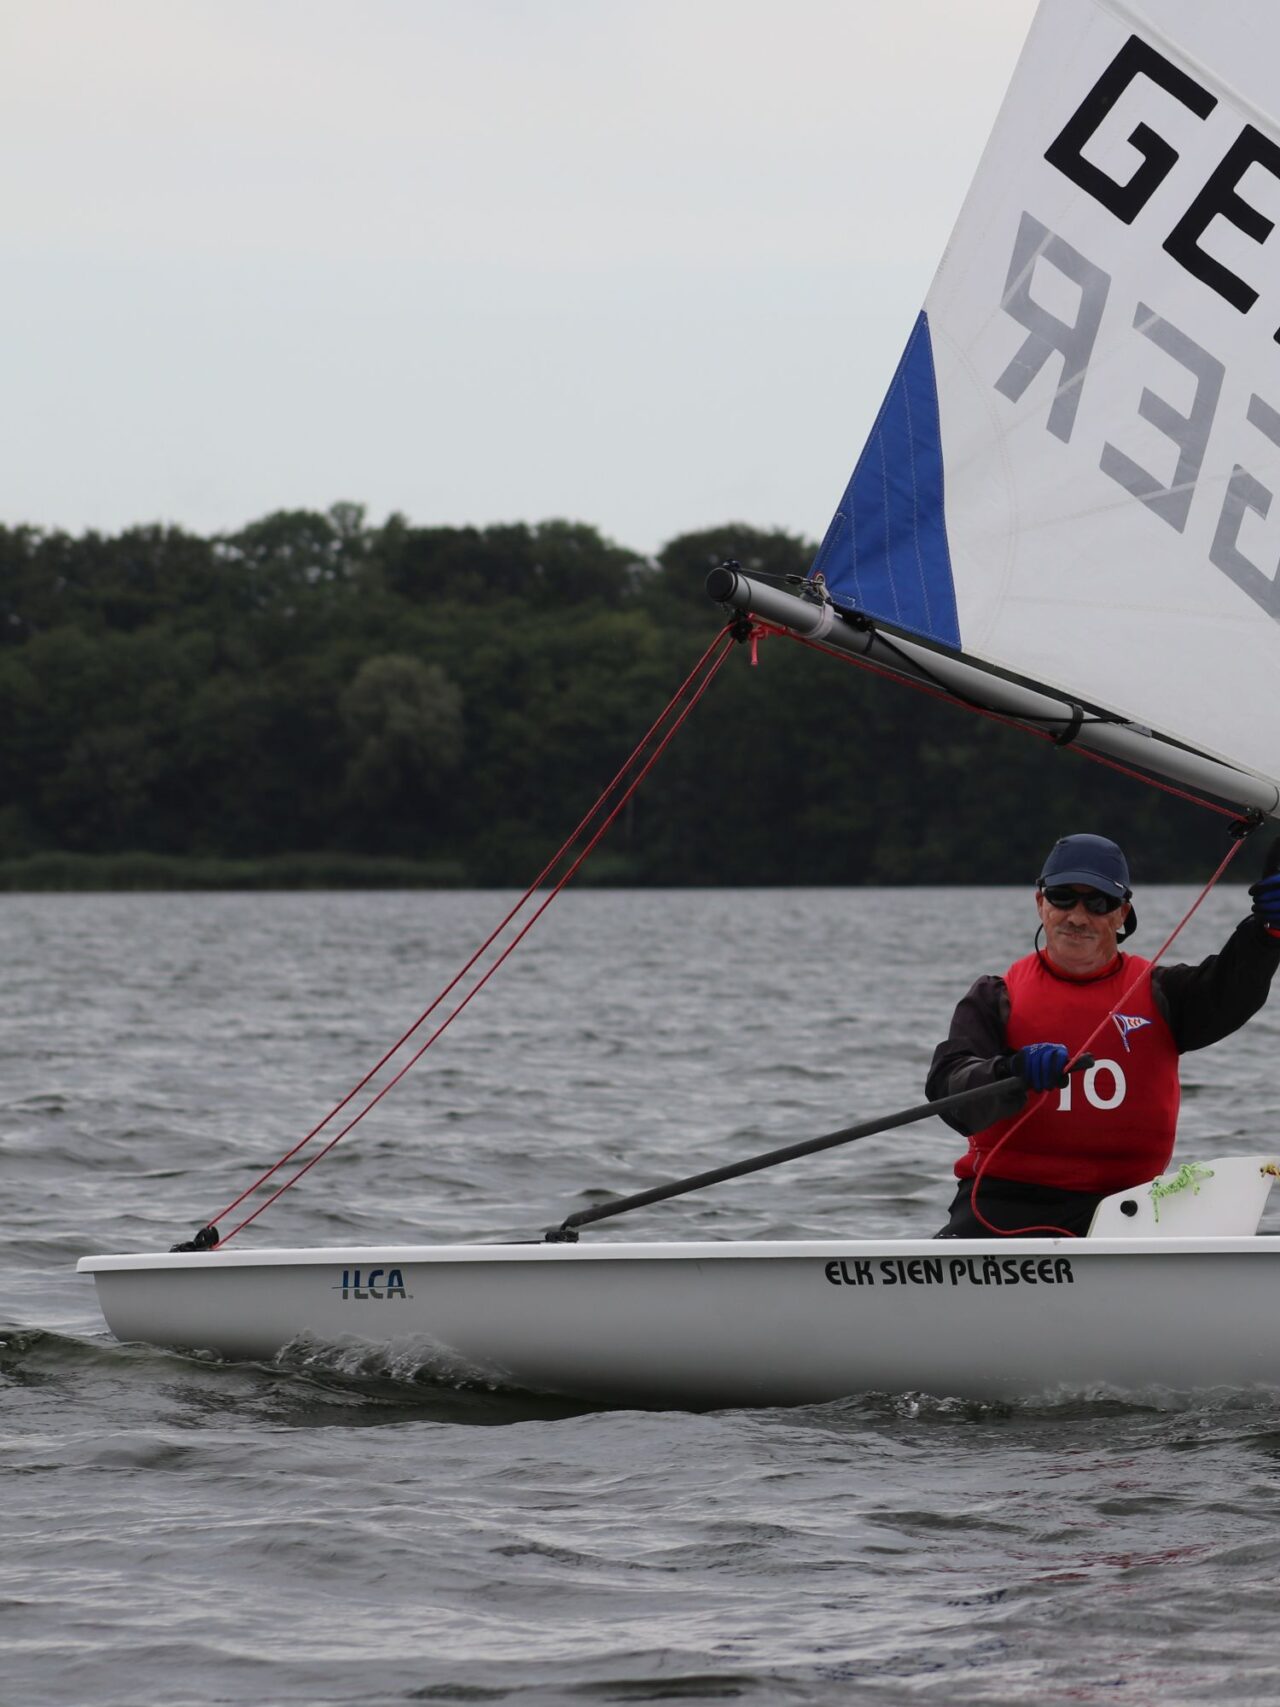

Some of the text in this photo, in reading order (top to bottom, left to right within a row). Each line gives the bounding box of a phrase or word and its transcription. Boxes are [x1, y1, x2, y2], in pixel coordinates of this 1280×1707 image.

[341, 1269, 407, 1300] ILCA
[824, 1255, 1075, 1286] ELK SIEN PLÄSEER
